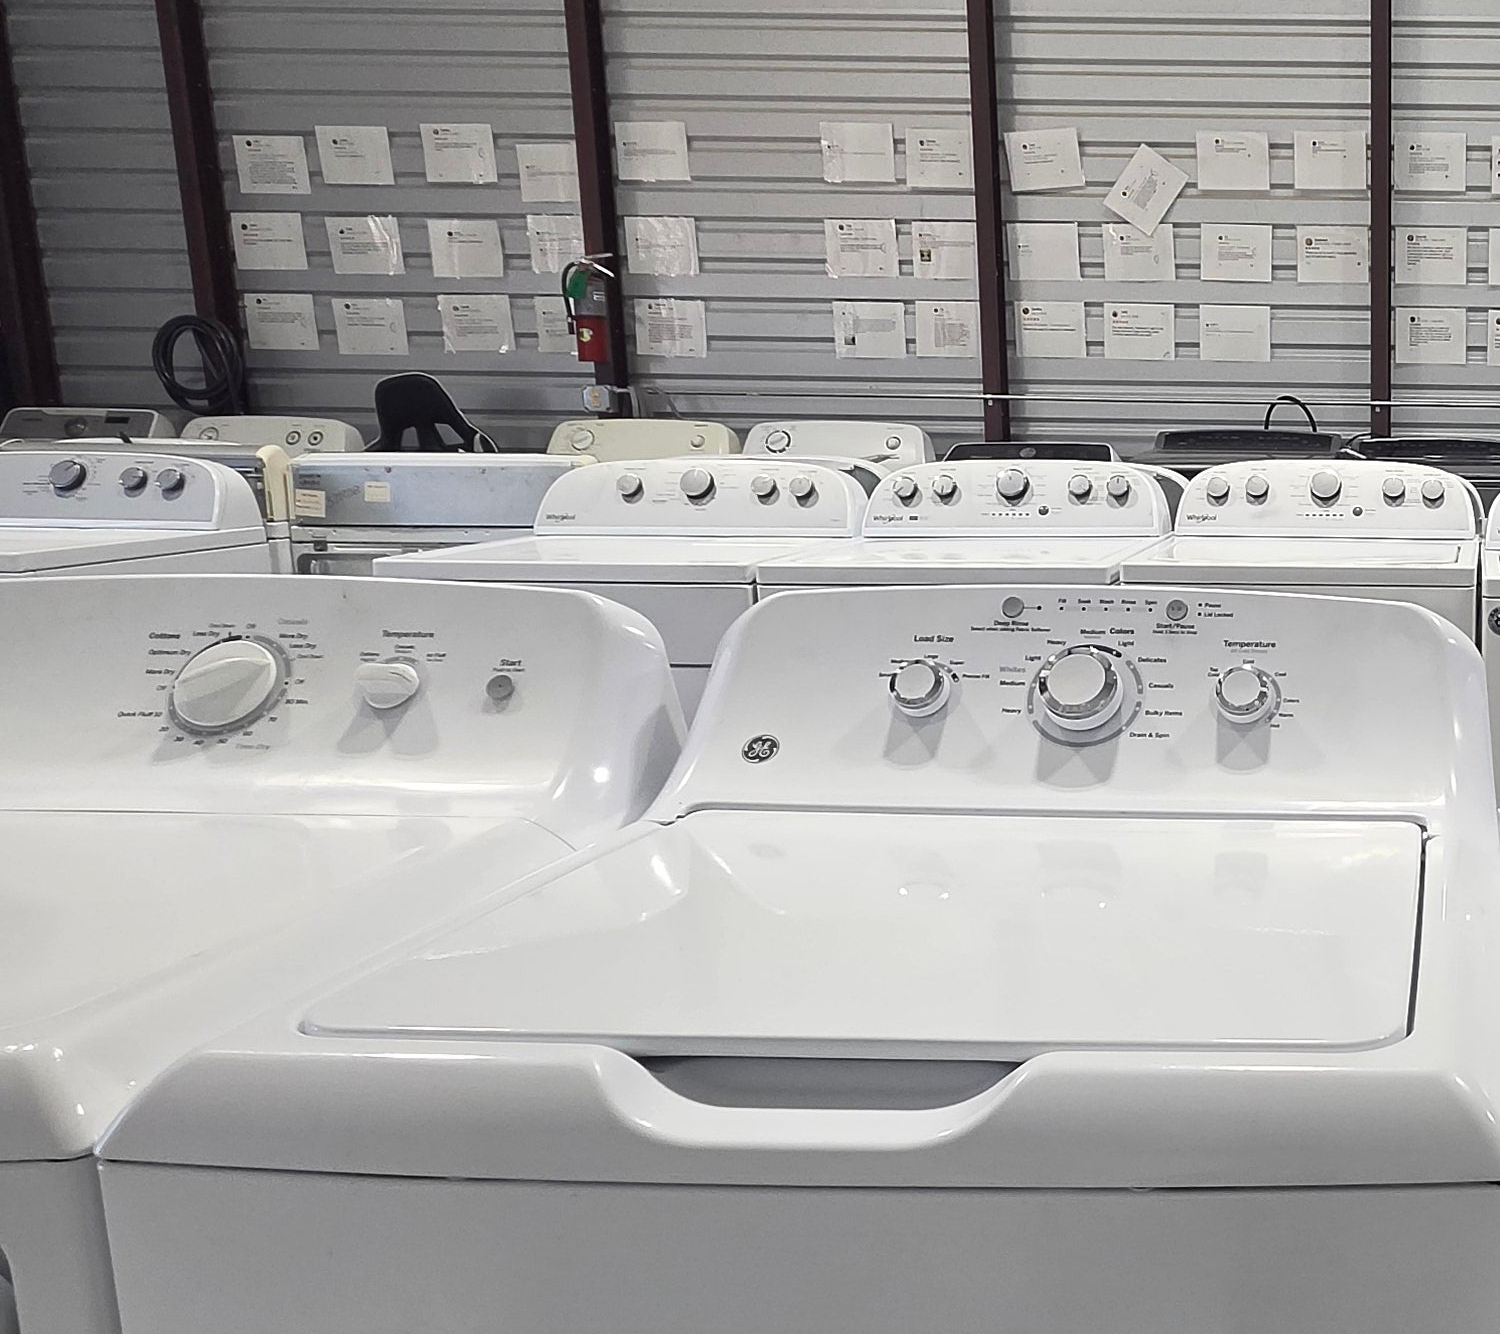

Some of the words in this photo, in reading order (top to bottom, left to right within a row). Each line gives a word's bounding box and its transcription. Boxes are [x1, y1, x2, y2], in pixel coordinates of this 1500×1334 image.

[382, 630, 434, 639] Temperature
[1109, 627, 1135, 635] Colors
[1223, 640, 1276, 648] Temperature
